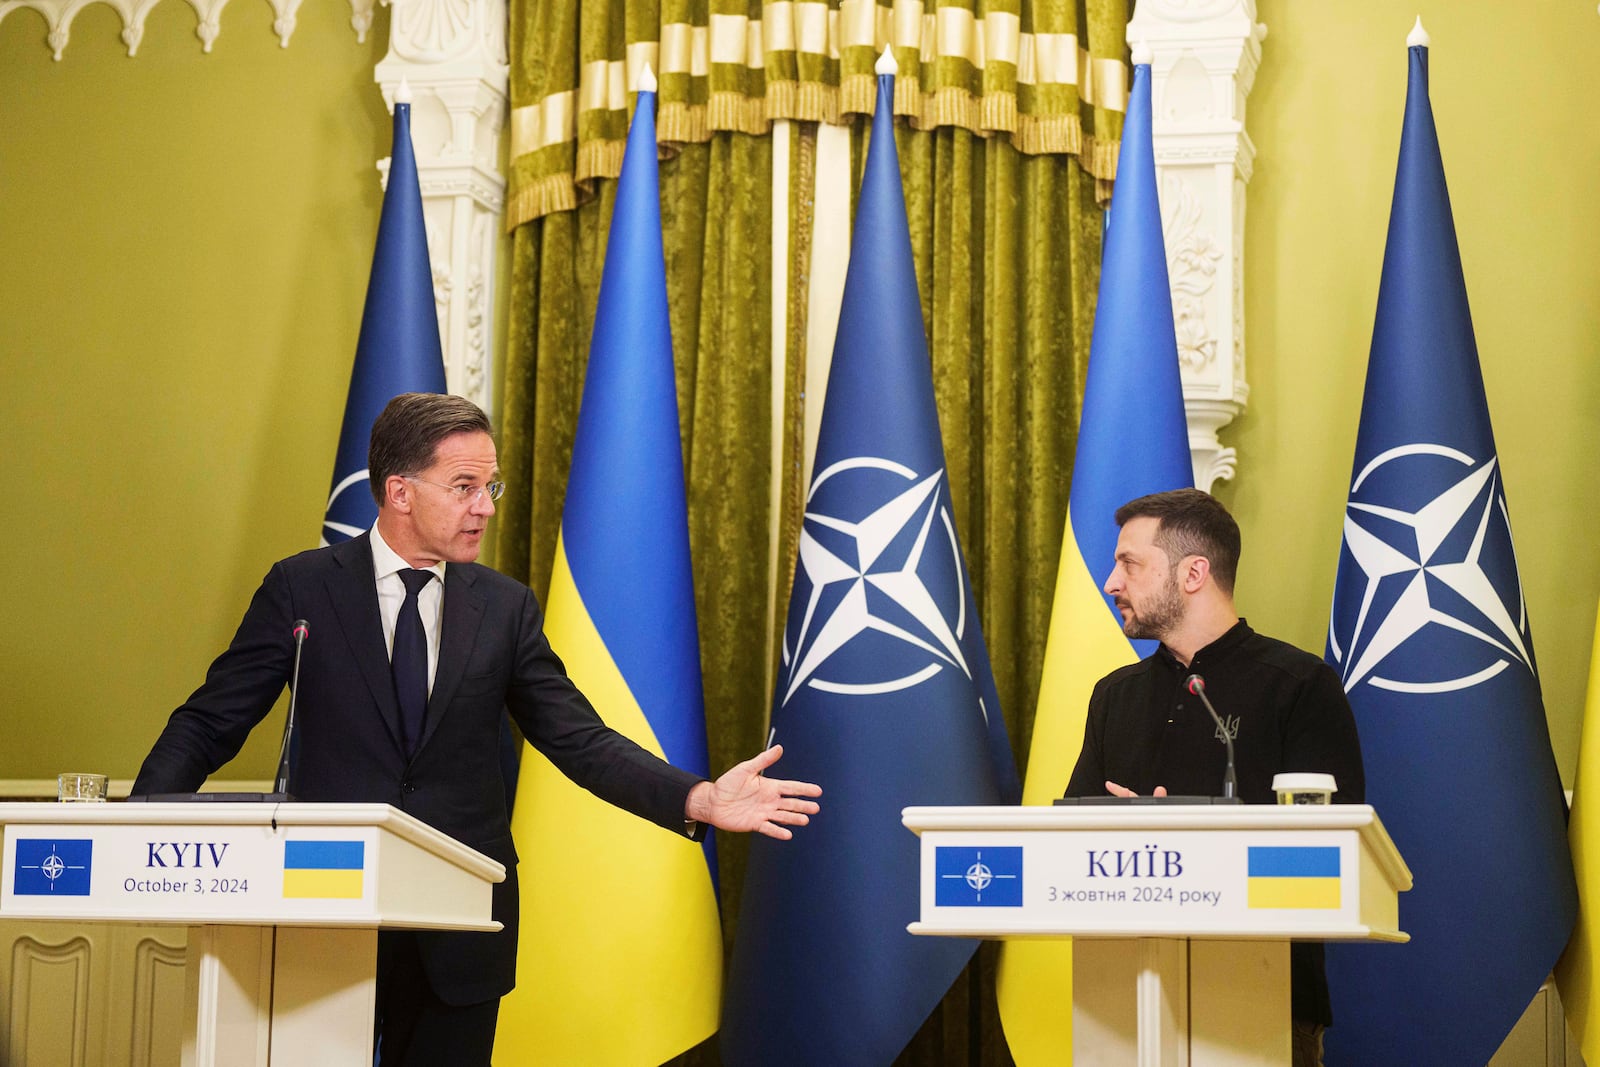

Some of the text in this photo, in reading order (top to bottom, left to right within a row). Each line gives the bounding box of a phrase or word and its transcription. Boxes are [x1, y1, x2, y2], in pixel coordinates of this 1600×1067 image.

[145, 842, 230, 868] KYIV
[1087, 844, 1184, 878] КИЇВ
[124, 878, 249, 895] October 3, 2024
[1048, 886, 1221, 907] 3 жовтня 2024 року
